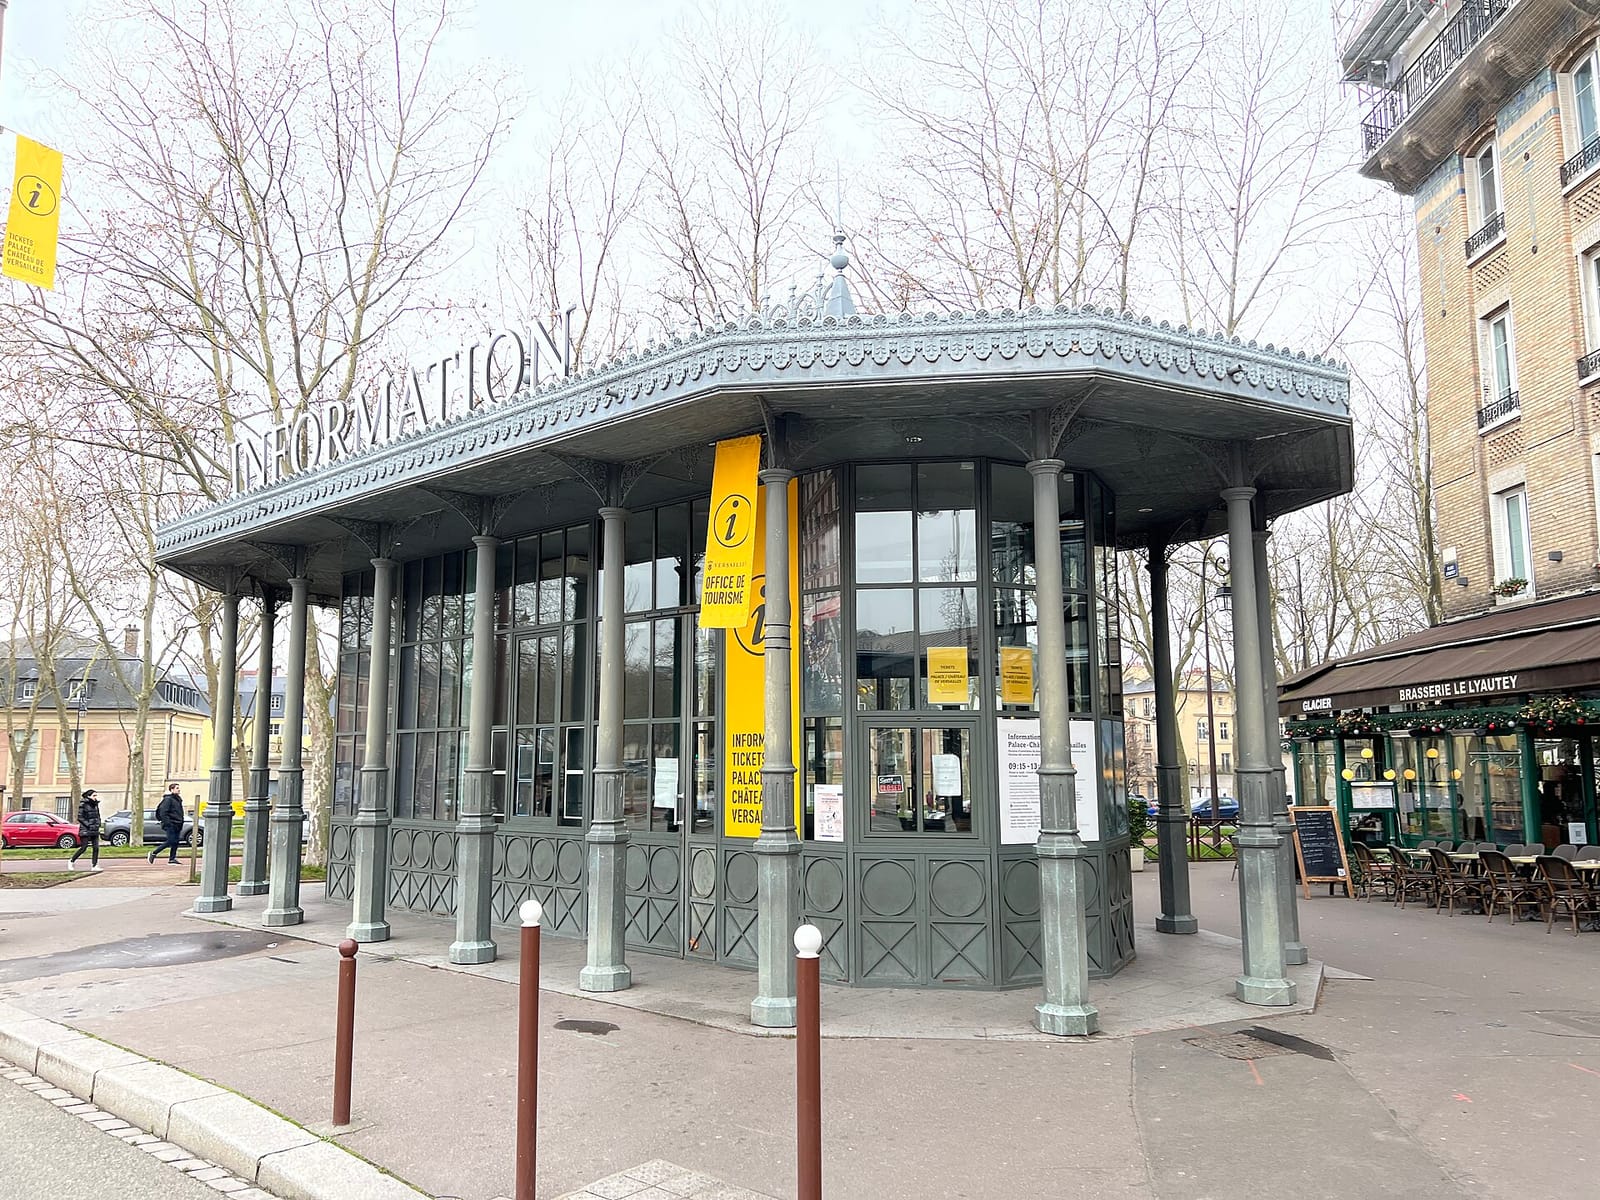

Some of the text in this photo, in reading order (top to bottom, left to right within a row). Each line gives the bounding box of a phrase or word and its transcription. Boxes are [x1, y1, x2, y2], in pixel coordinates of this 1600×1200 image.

[9, 232, 34, 247] TICKETS
[8, 240, 31, 255] PALACE
[7, 257, 44, 275] VERSAILLES
[36, 258, 45, 268] DE
[229, 303, 577, 495] INFORMATION
[705, 574, 746, 590] OFFICE DE
[704, 590, 744, 605] TOURISME
[1399, 675, 1518, 701] BRASSERIE LE LYAUTEY
[1302, 697, 1332, 712] GLACIER
[732, 733, 765, 747] INFORM
[732, 786, 763, 804] CHÂTEA
[732, 808, 763, 823] VERSAI
